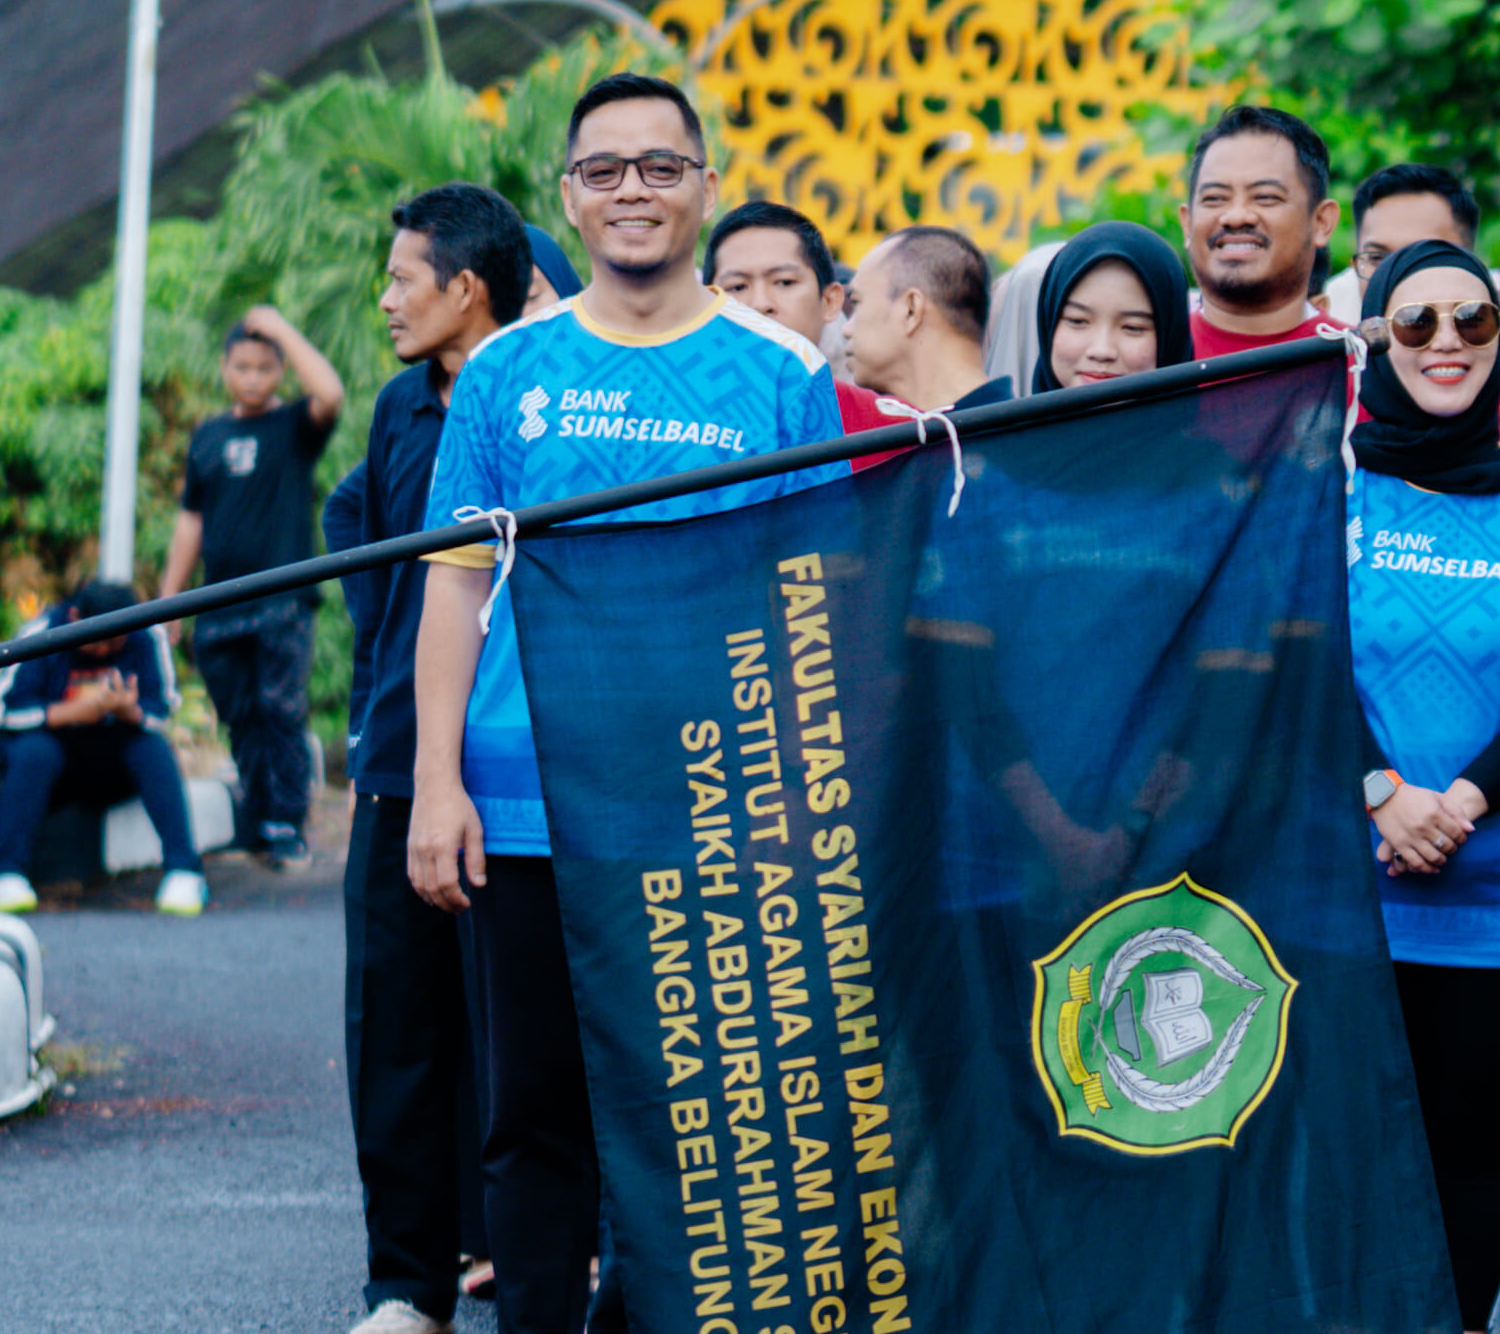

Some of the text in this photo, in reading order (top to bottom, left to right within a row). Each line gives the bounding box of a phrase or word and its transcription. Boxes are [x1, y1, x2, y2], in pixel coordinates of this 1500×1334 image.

[558, 414, 745, 453] SUMSELBABEL
[559, 388, 631, 412] BANK
[1372, 530, 1437, 553] BANK
[725, 628, 790, 845] INSTITUT
[777, 552, 851, 814] FAKULTAS
[680, 719, 740, 897] SYAIKH
[642, 868, 704, 1088] BANGKA
[753, 861, 813, 1048] AGAMA
[812, 824, 880, 1055] SYARIAH
[703, 910, 792, 1311] ABDURRAHMAN
[778, 1055, 835, 1212] ISLAM
[844, 1063, 895, 1174] DAN
